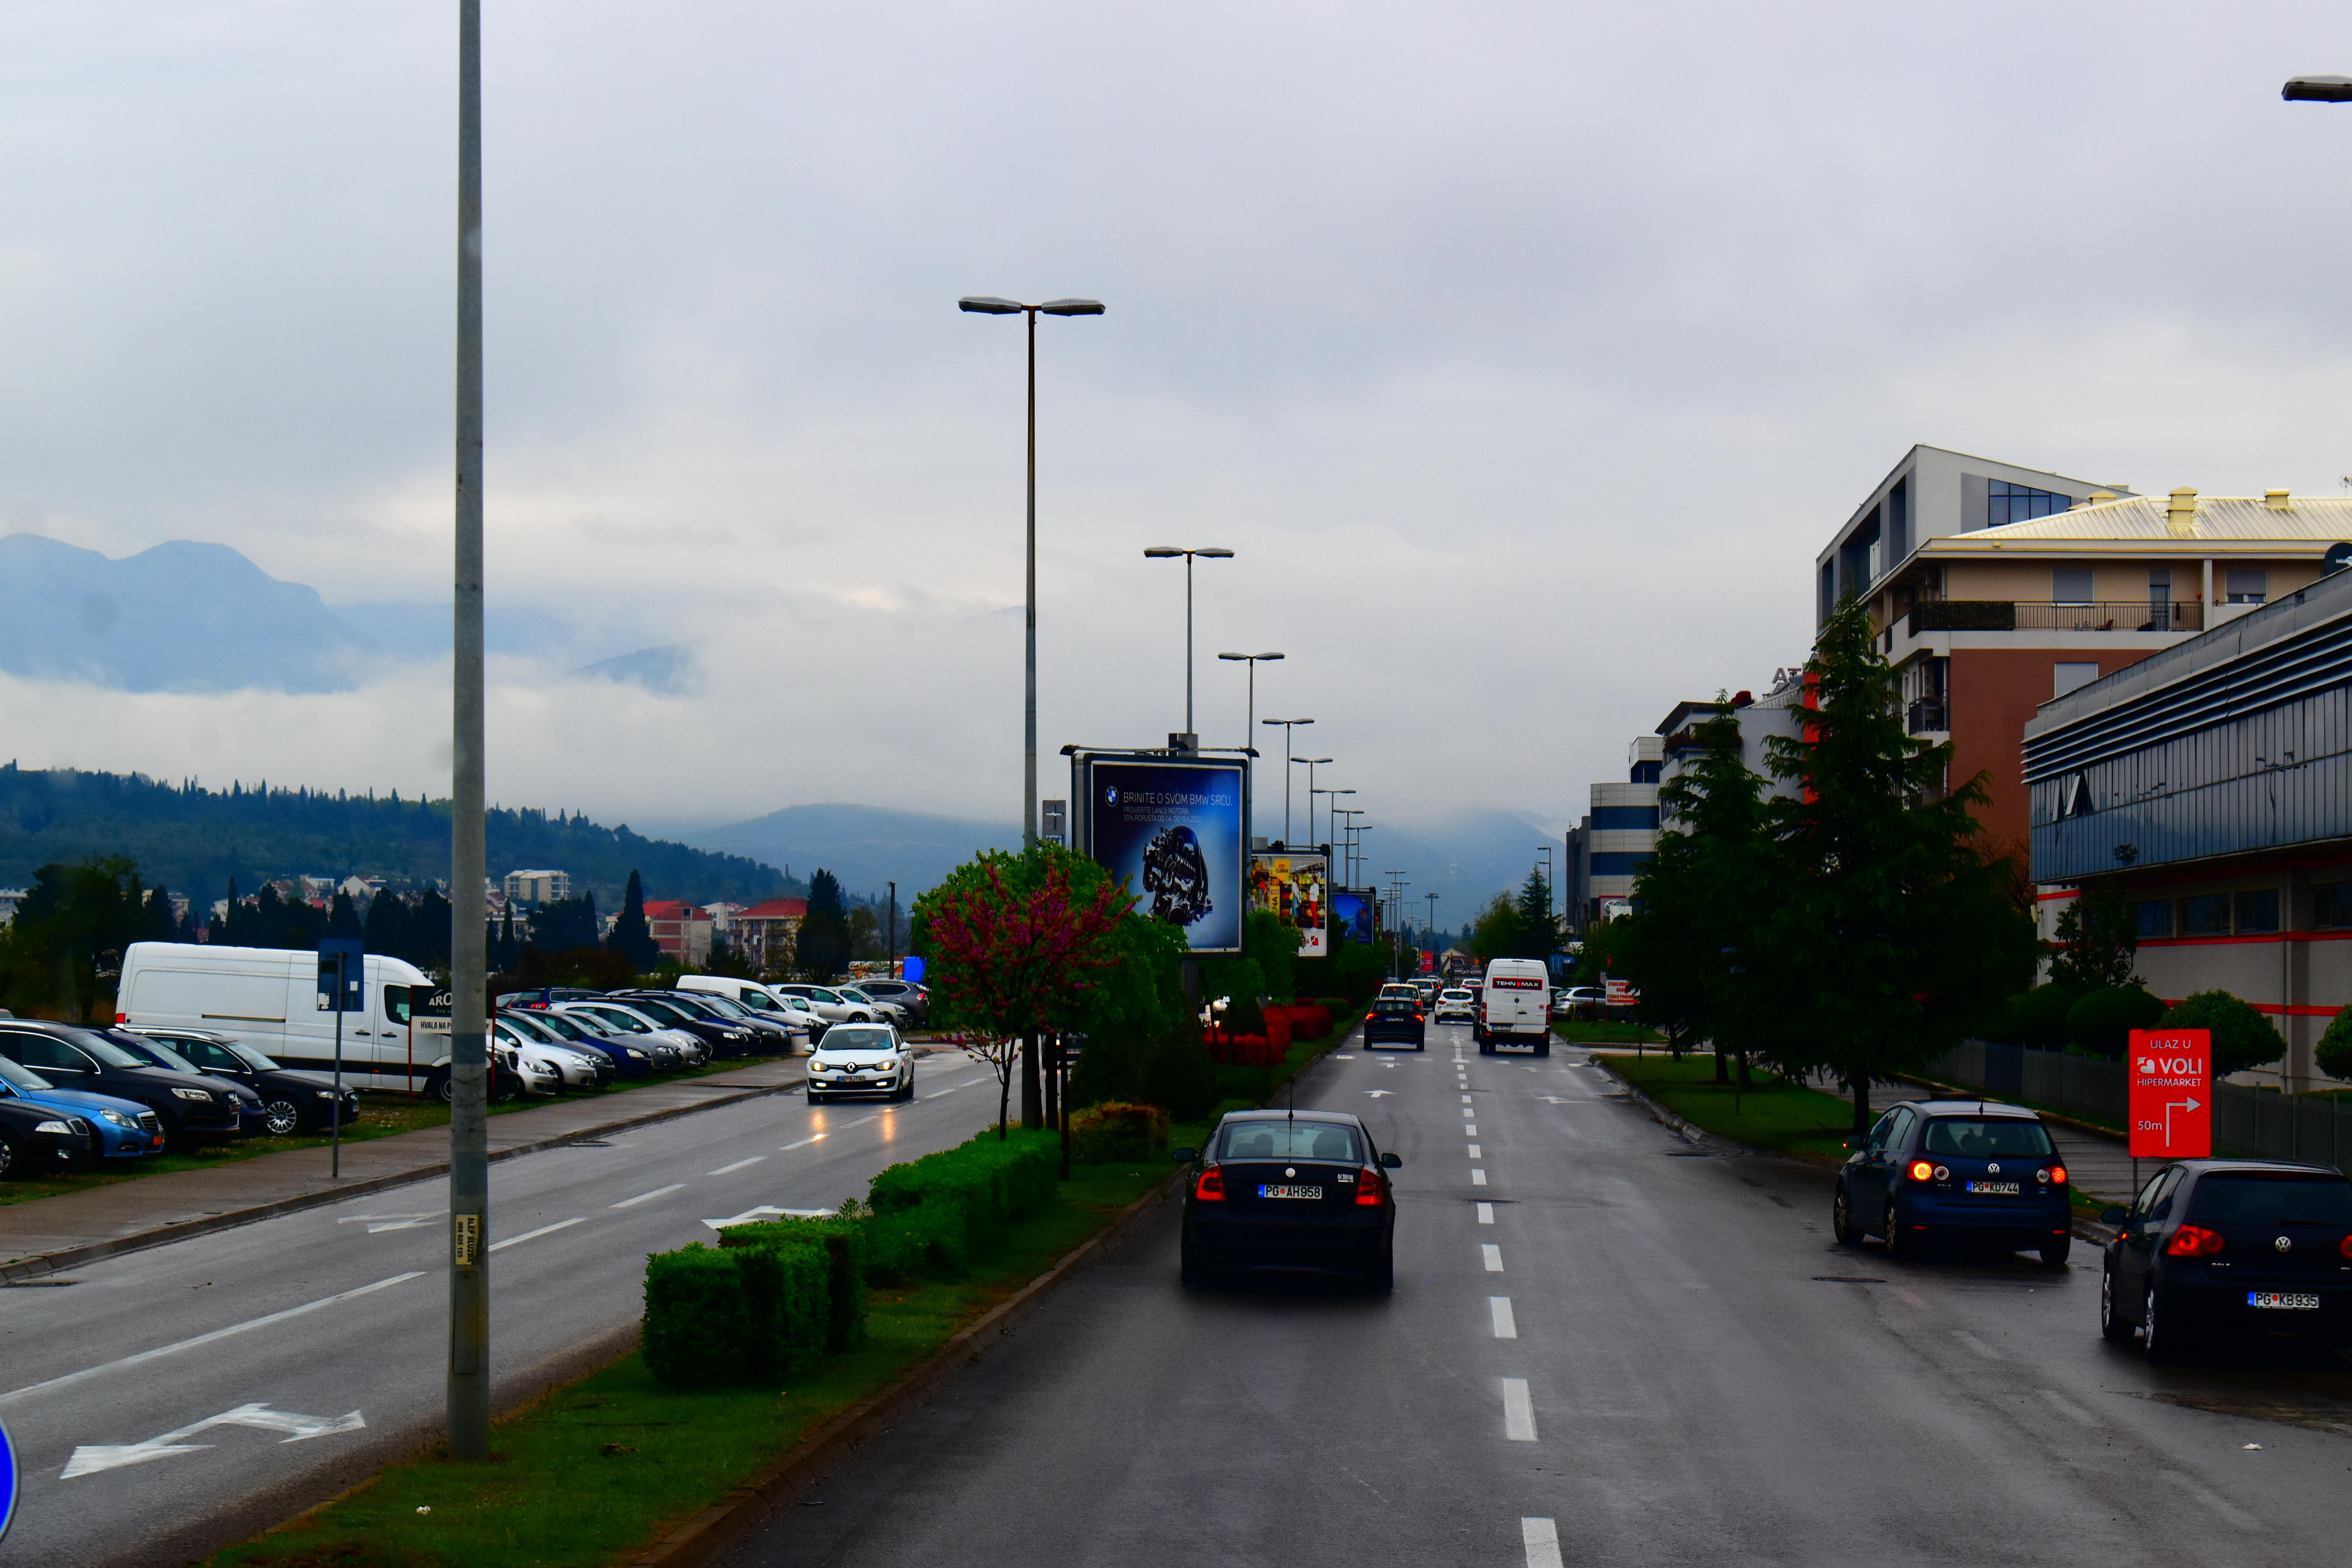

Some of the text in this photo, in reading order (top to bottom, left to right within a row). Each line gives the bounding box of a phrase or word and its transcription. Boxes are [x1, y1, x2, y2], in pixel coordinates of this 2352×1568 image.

[1123, 792, 1232, 806] BRINITE O SVOM BMW SRCU.
[421, 1021, 437, 1029] HVALA
[2150, 1040, 2191, 1049] ULAZ U
[2159, 1058, 2202, 1074] VOLI
[2137, 1078, 2201, 1086] HIPERMARKET
[2138, 1120, 2162, 1130] 50m
[1266, 1185, 1320, 1197] PG AH958
[1973, 1182, 2018, 1192] PG KD744
[2256, 1293, 2317, 1307] PG KB935
